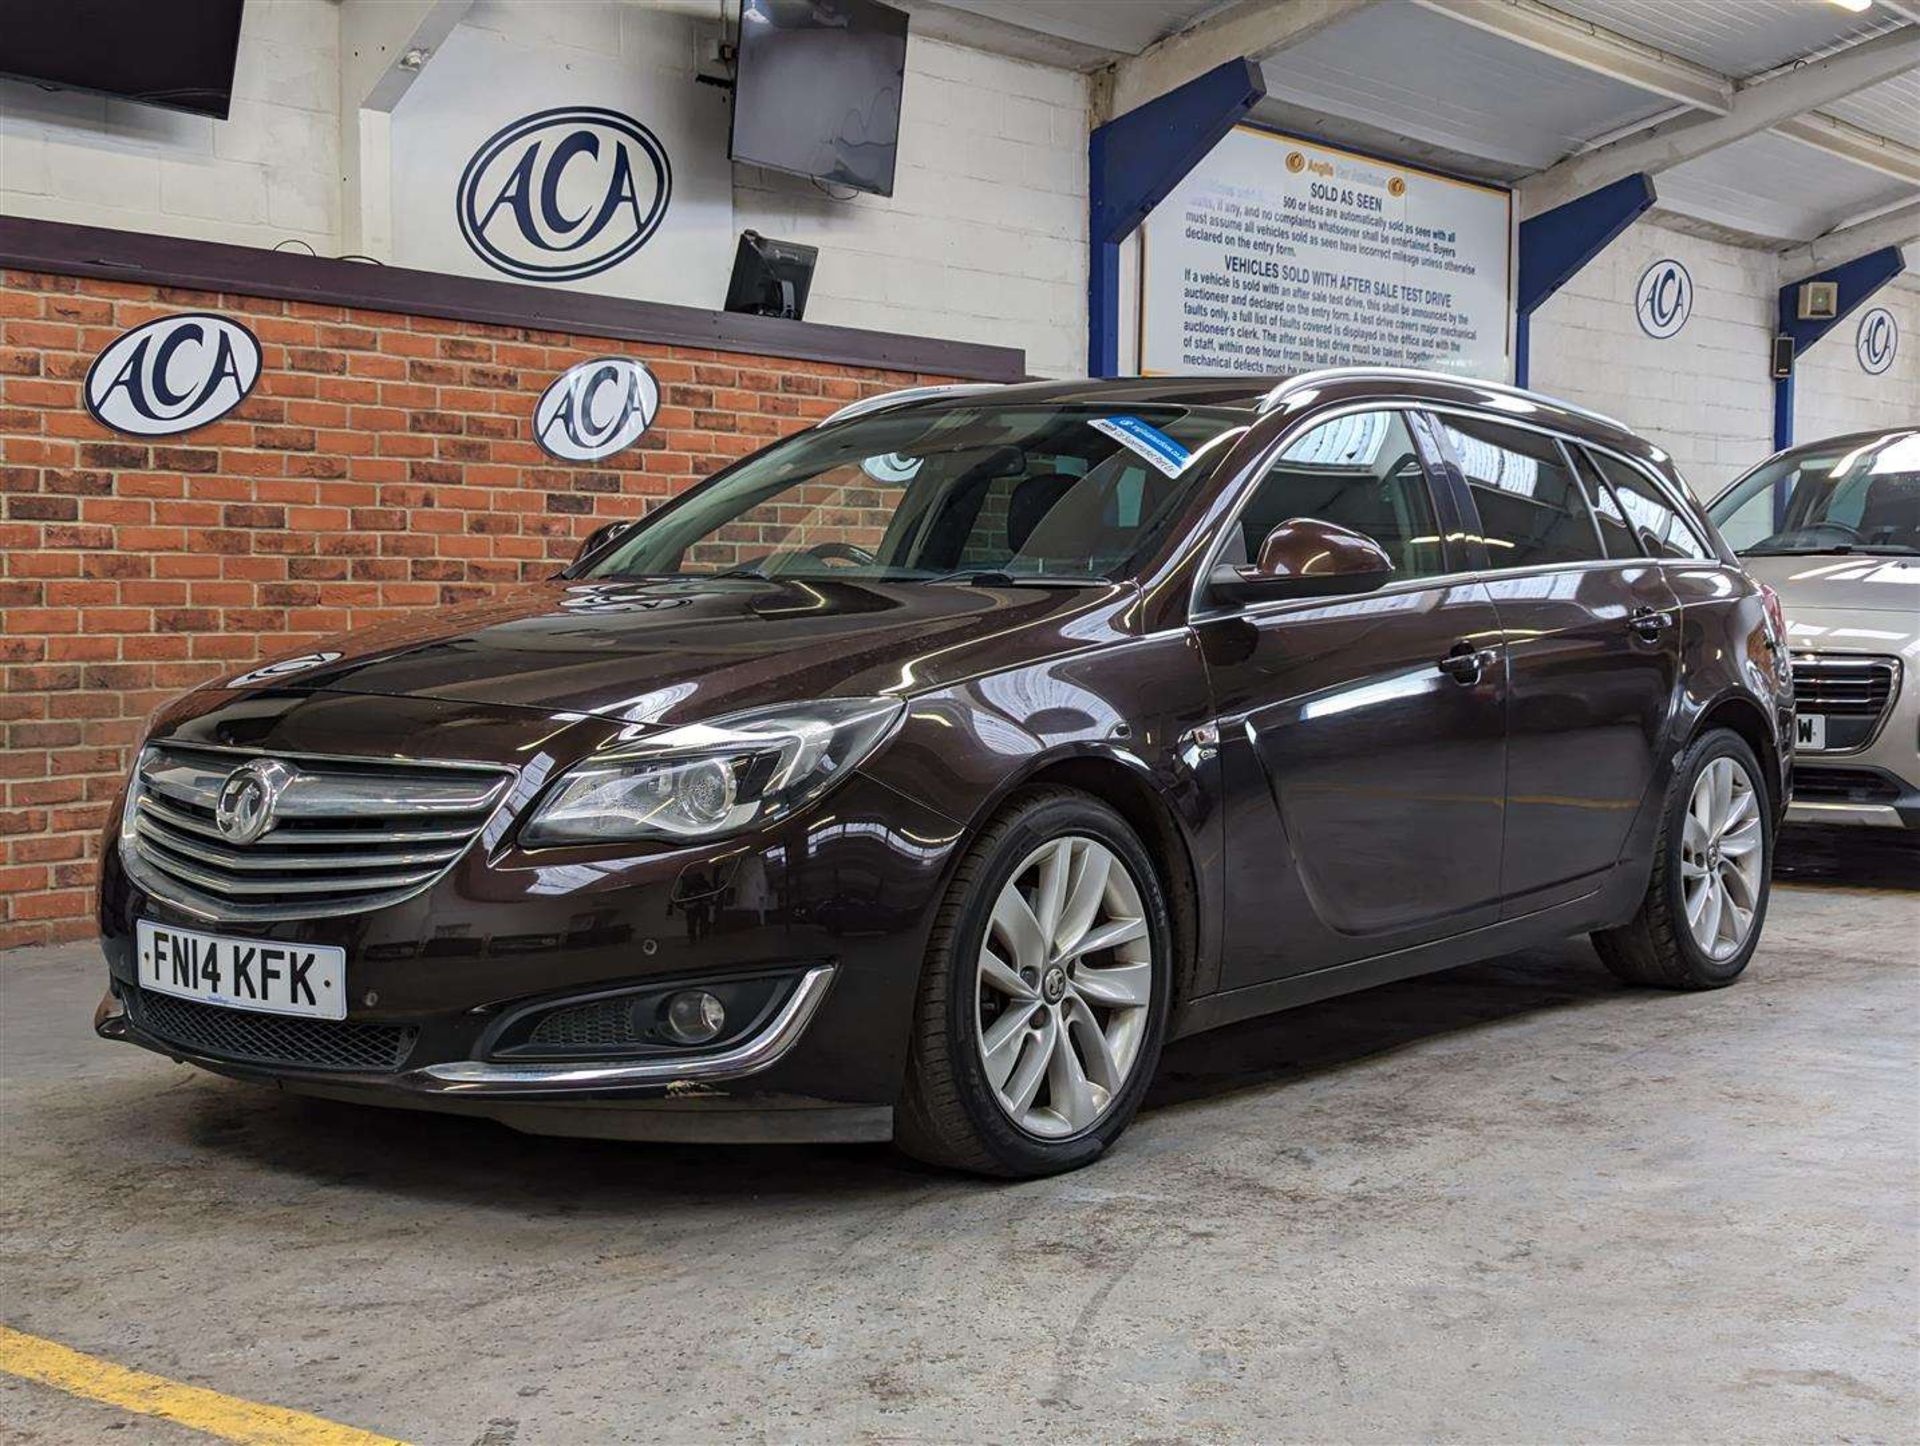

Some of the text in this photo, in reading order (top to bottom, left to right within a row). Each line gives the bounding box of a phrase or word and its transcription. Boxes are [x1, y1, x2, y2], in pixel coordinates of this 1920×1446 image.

[475, 130, 643, 252] ACA
[1310, 182, 1382, 212] SOLD AS SEEN
[1186, 226, 1222, 244] declared
[1224, 234, 1236, 246] on
[1238, 235, 1251, 250] the
[1252, 239, 1274, 256] entry
[1186, 210, 1476, 275] must assume all vehicles sold as seen have incorrect mileage unless otherwise
[1244, 206, 1260, 218] and
[1262, 210, 1272, 220] no
[1274, 212, 1316, 229] complaints
[1318, 222, 1360, 238] whatsoever
[1362, 230, 1380, 242] shall
[1381, 232, 1389, 244] be
[1433, 242, 1456, 258] Buyers
[1298, 202, 1306, 211] or
[1308, 201, 1324, 216] less
[1326, 208, 1338, 218] are
[1340, 210, 1386, 230] automatically
[1388, 220, 1403, 232] sold
[1406, 224, 1414, 234] as
[1415, 226, 1431, 238] seen
[1432, 230, 1446, 240] with
[1184, 268, 1191, 280] If
[1192, 272, 1198, 282] a
[1200, 272, 1230, 288] vehicle
[1232, 276, 1240, 289] is
[1242, 280, 1260, 292] sold
[1262, 282, 1280, 295] with
[1282, 286, 1291, 296] an
[1292, 287, 1310, 300] after
[1312, 291, 1328, 304] sale
[1329, 293, 1344, 306] test
[1366, 298, 1380, 311] this
[1382, 302, 1400, 314] shall
[1401, 305, 1410, 316] be
[1411, 308, 1447, 322] announced
[1448, 312, 1456, 326] by
[1458, 313, 1468, 326] the
[1224, 254, 1452, 308] VEHICLES SOLD WITH AFTER SALE TEST DRIVE
[1640, 268, 1684, 328] ACA
[1184, 288, 1230, 303] auctioneer
[1231, 294, 1248, 306] and
[1248, 296, 1284, 312] declared
[1286, 303, 1296, 313] on
[1297, 303, 1310, 316] the
[1311, 307, 1330, 321] entry
[1360, 314, 1374, 326] test
[1376, 314, 1394, 328] drive
[1395, 320, 1418, 332] covers
[1420, 324, 1438, 336] major
[1440, 326, 1477, 340] mechanical
[1184, 302, 1208, 317] faults
[1210, 307, 1230, 322] only,
[1232, 311, 1238, 320] a
[1240, 310, 1253, 323] full
[1254, 312, 1268, 325] list
[1268, 315, 1278, 326] of
[1280, 317, 1300, 330] faults
[1302, 322, 1332, 334] covered
[1334, 324, 1340, 336] is
[1342, 324, 1378, 342] displayed
[1388, 332, 1399, 343] the
[1400, 334, 1420, 346] office
[1422, 338, 1434, 348] and
[1436, 340, 1449, 350] with
[1184, 321, 1235, 337] auctioneer's
[1262, 328, 1277, 342] The
[1279, 332, 1297, 345] after
[1298, 336, 1314, 347] sale
[1316, 337, 1330, 350] test
[1332, 340, 1350, 352] drive
[1352, 344, 1370, 354] must
[1372, 344, 1380, 356] be
[1183, 336, 1192, 348] of
[1218, 340, 1244, 354] within
[1245, 345, 1260, 356] one
[1262, 345, 1280, 358] hour
[1282, 348, 1300, 360] from
[1302, 350, 1314, 362] the
[1183, 354, 1232, 369] mechanical
[1233, 358, 1264, 373] defects
[1266, 363, 1286, 374] must
[1860, 316, 1892, 365] ACA
[95, 323, 244, 421] ACA
[540, 366, 648, 449] ACA
[154, 931, 316, 1006] FN14 KFK
